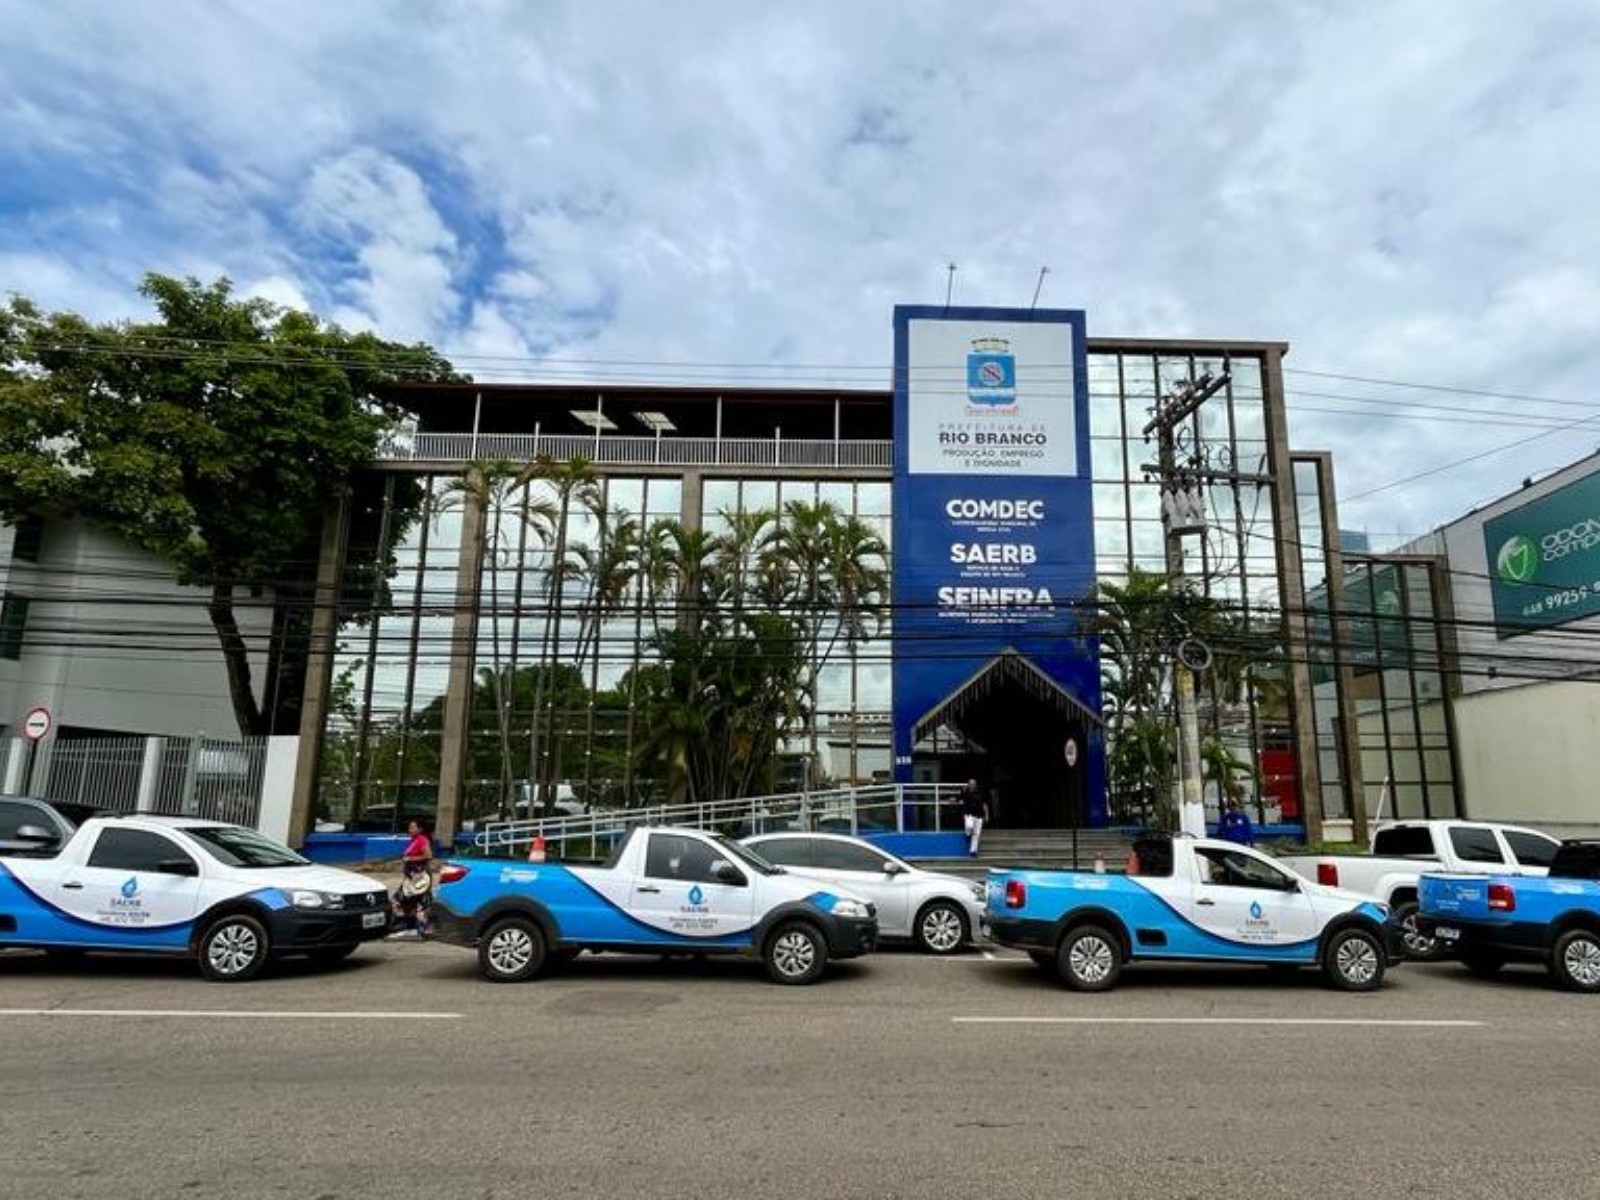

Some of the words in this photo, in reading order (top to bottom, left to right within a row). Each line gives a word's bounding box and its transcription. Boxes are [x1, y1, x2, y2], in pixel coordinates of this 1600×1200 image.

[939, 432, 969, 444] RIO
[975, 432, 1047, 445] BRANCO
[946, 499, 1045, 520] COMDEC
[950, 543, 1037, 564] SAERB
[937, 586, 1053, 606] SEINFRA
